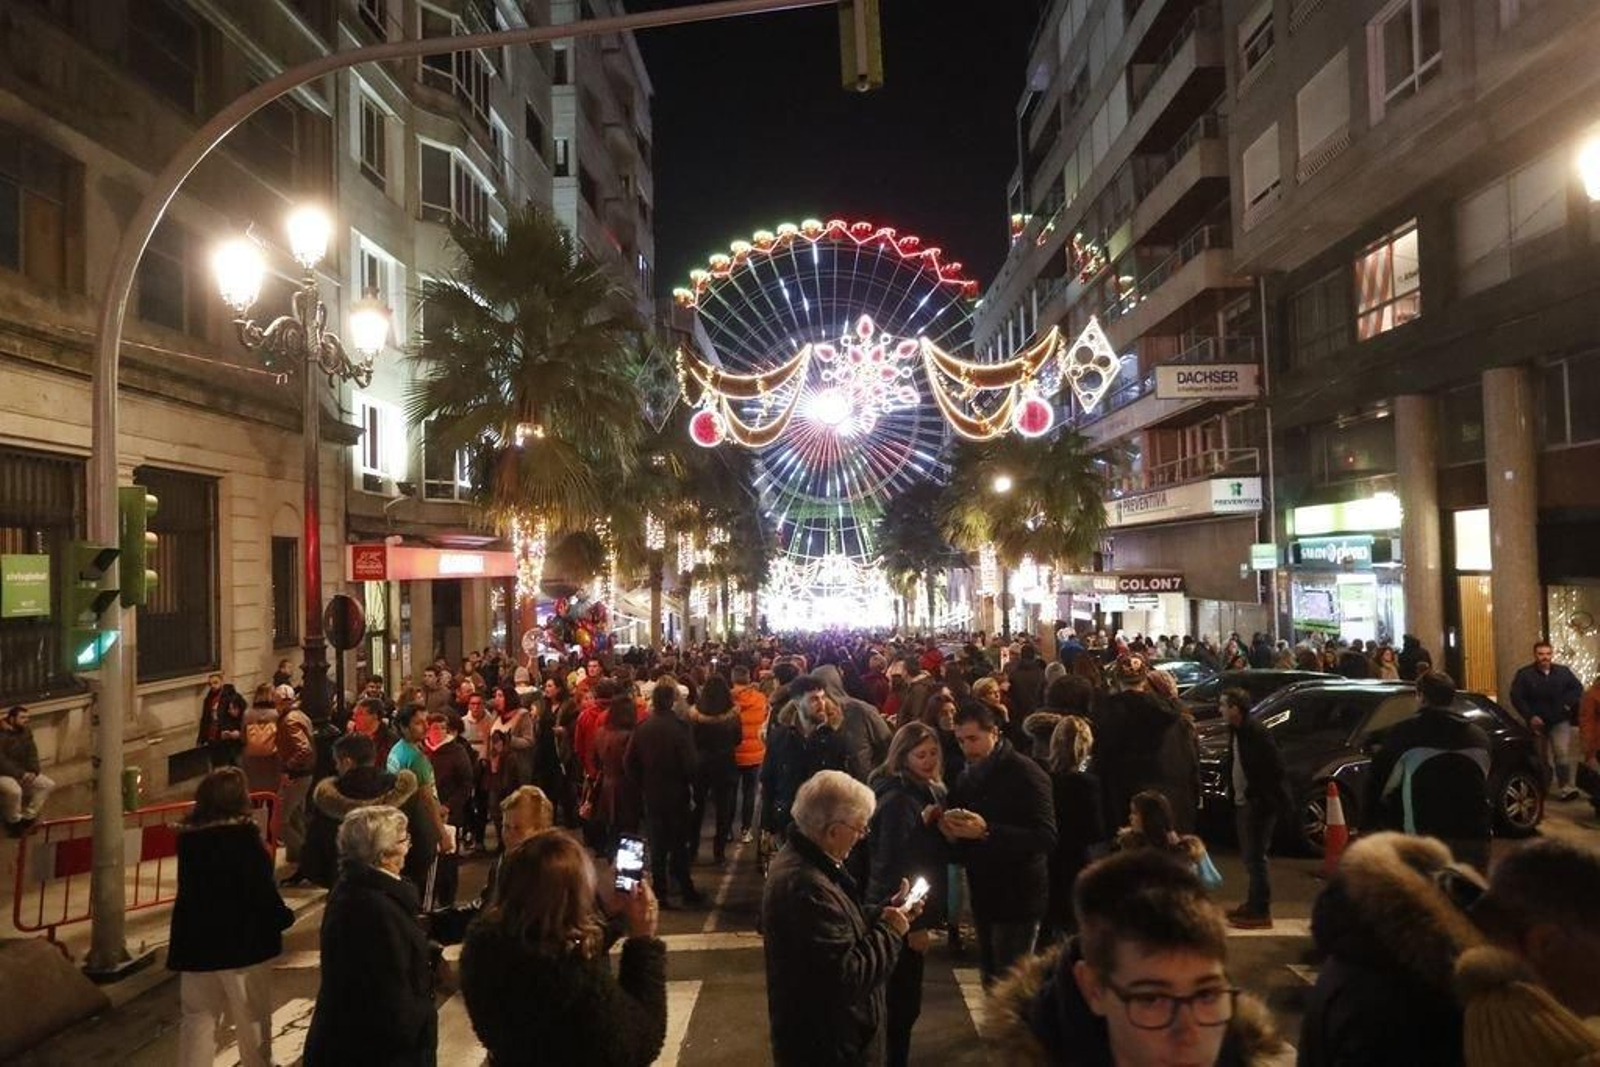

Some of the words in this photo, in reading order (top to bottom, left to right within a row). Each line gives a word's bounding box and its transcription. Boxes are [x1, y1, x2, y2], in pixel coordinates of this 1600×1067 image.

[1177, 370, 1238, 384] DACHSER
[1123, 491, 1168, 513] PREVENTIVA
[1214, 497, 1260, 506] PREVENTIVA
